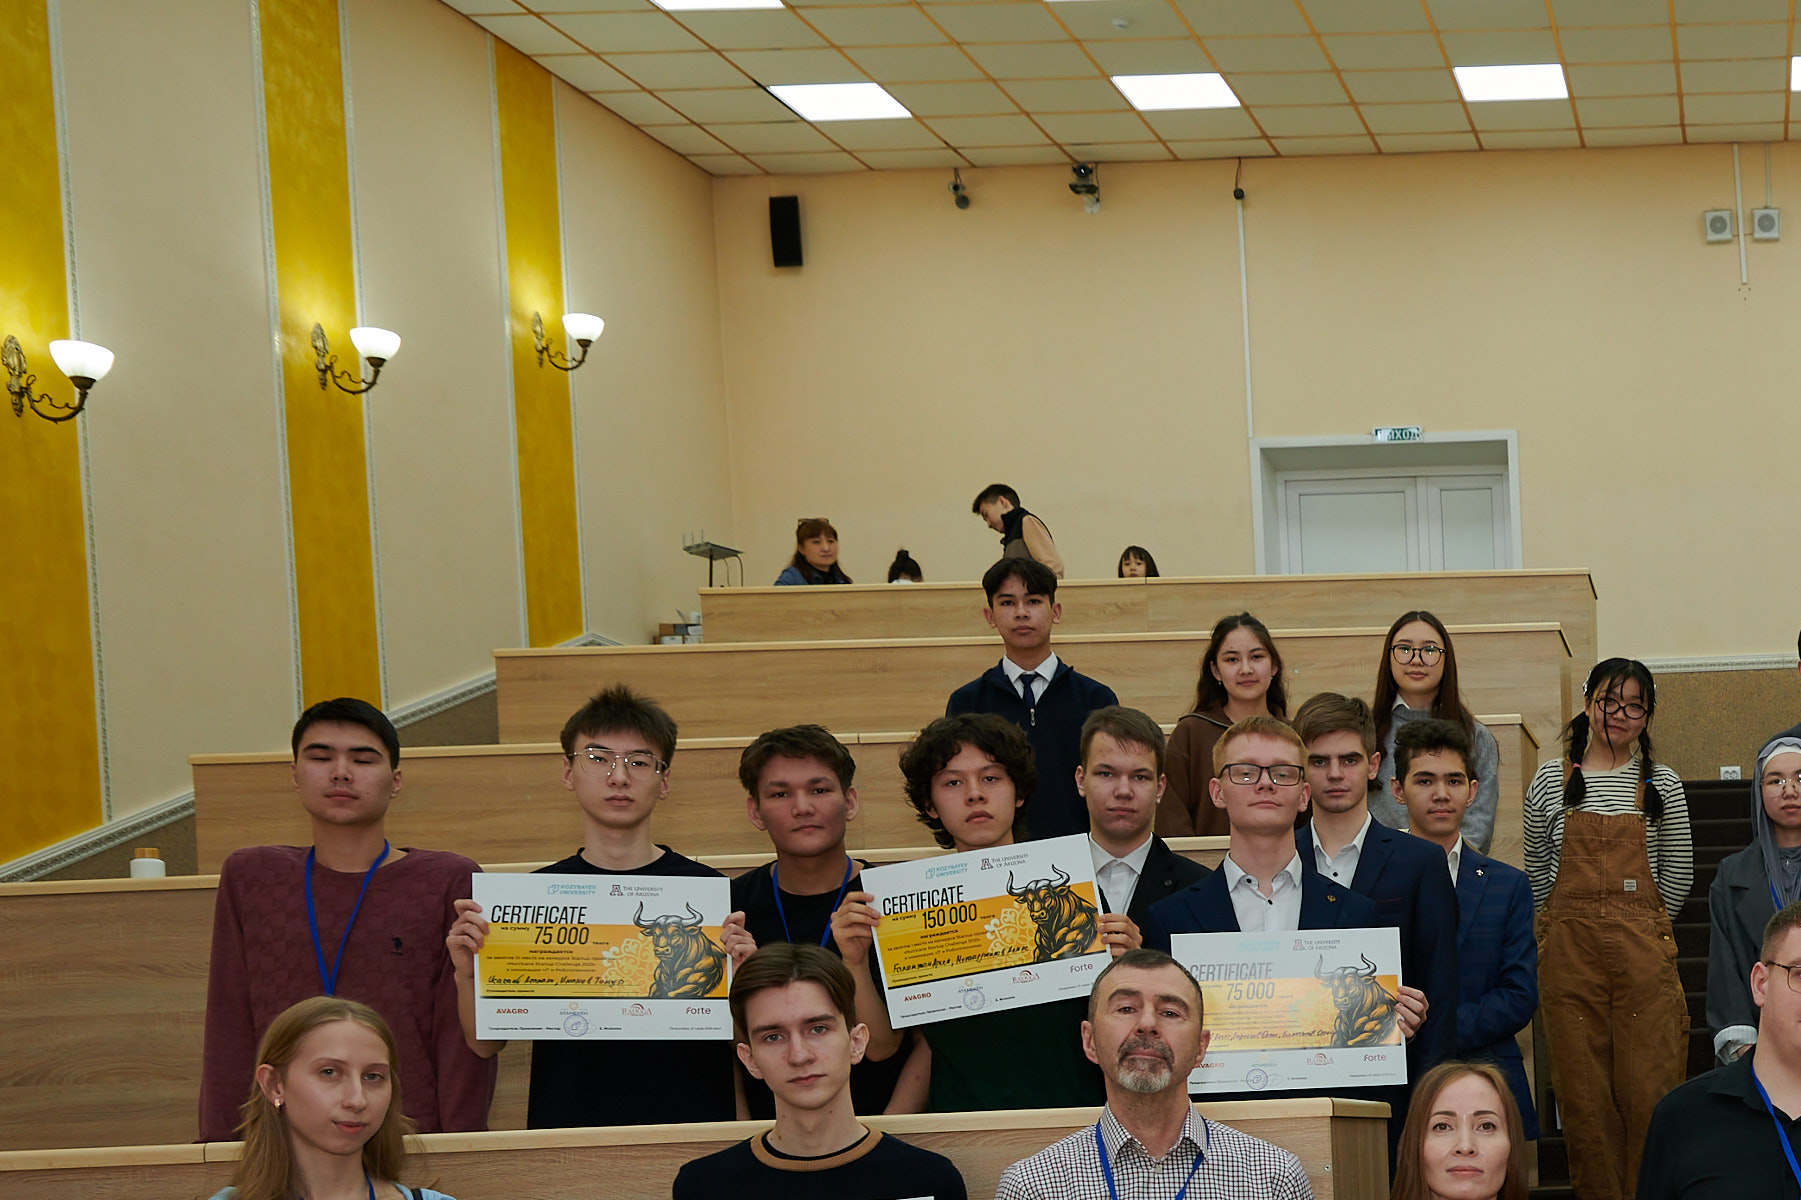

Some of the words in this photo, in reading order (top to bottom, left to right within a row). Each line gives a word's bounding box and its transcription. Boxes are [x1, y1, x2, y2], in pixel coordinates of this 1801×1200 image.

[881, 884, 964, 916] CERTIFICATE
[490, 904, 587, 924] CERTIFICATE
[923, 907, 945, 929] 150
[949, 902, 977, 925] 000
[534, 925, 553, 944] 75
[556, 926, 589, 945] 000
[1189, 961, 1273, 982] CERTIFICATE
[903, 990, 932, 1001] AVAGRO
[1226, 982, 1242, 1001] 75
[1246, 981, 1275, 1000] 000
